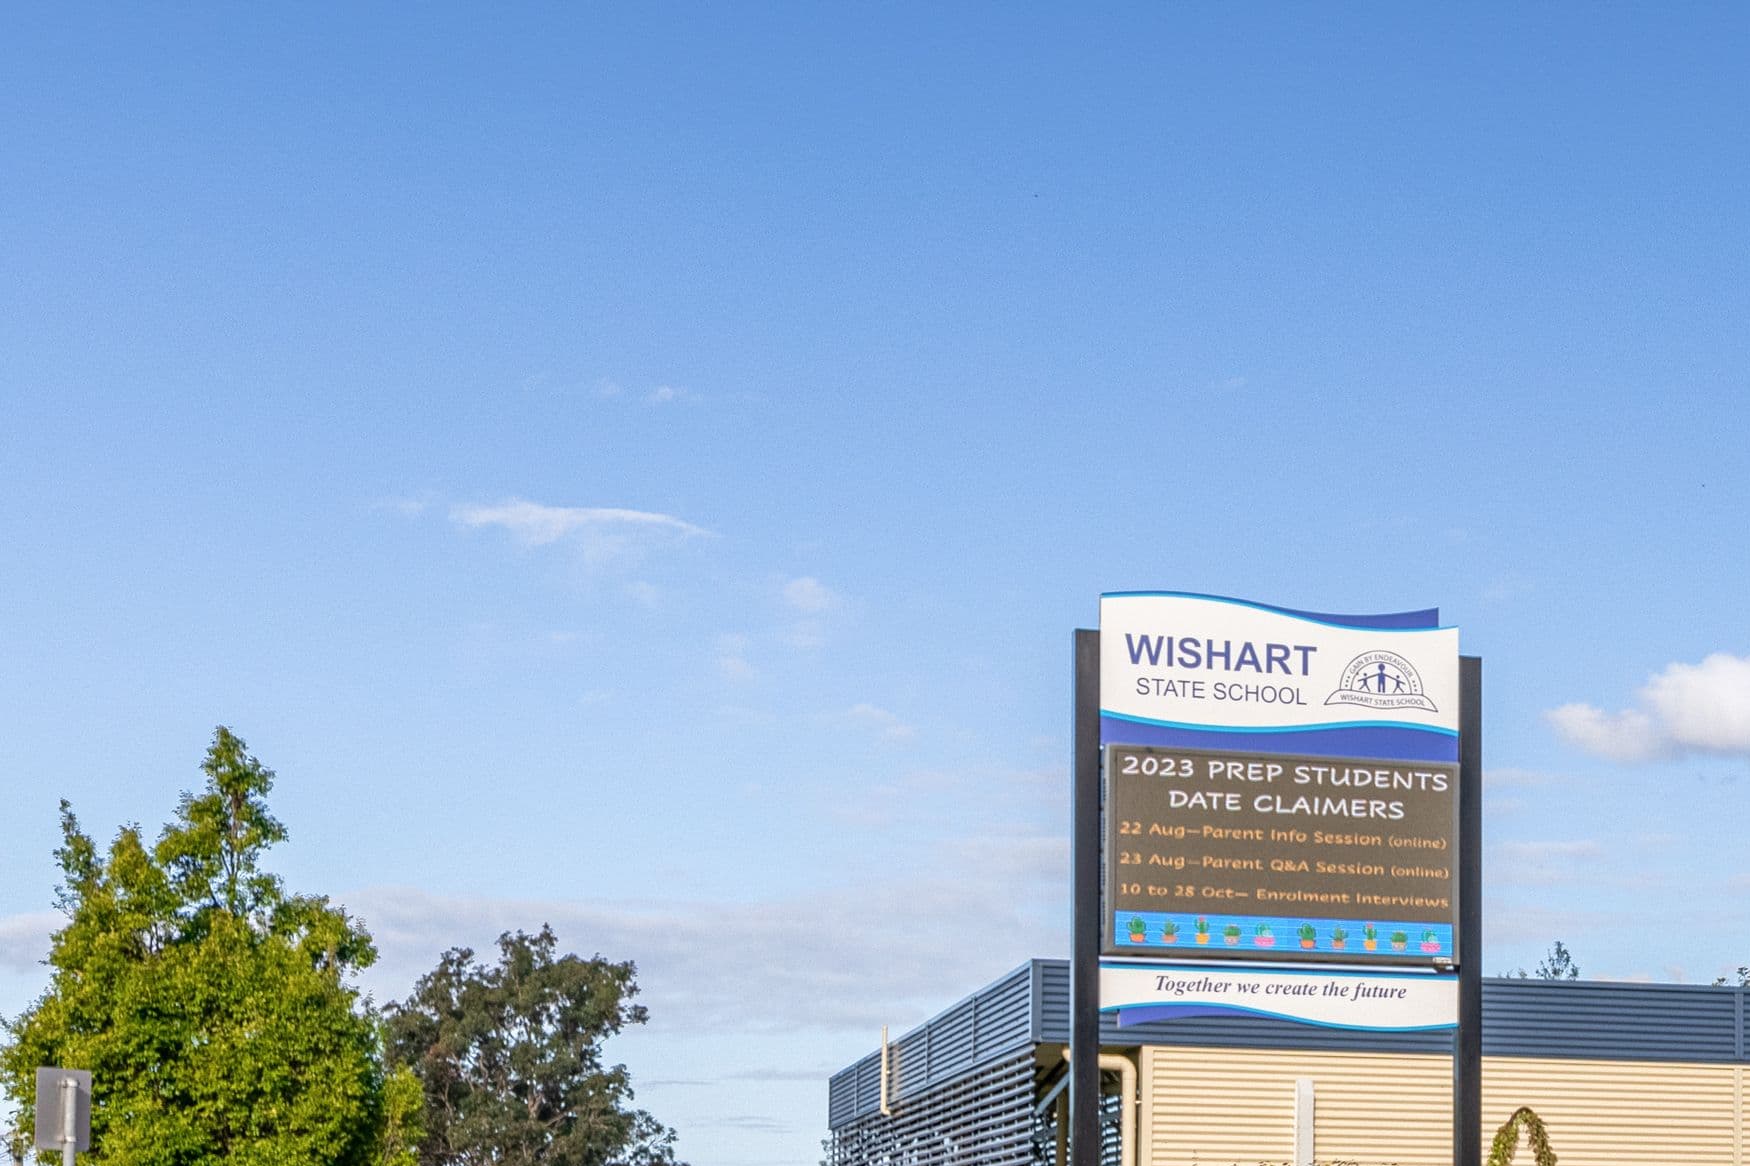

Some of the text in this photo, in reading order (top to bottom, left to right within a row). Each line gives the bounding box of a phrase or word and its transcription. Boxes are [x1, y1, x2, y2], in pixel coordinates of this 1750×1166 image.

[1125, 633, 1317, 676] WISHART
[1349, 654, 1414, 677] GAIN BY ENDEAVOUR
[1136, 677, 1307, 706] STATE SCHOOL
[1340, 694, 1425, 706] WISHART STATE SCHOOL
[1121, 756, 1449, 792] 2023 PREP STUDENTS
[1169, 790, 1405, 819] DATE CLAIMERS
[1119, 821, 1142, 835] 22
[1271, 829, 1307, 842] Info
[1314, 830, 1382, 846] Session
[1388, 835, 1448, 850] (online)
[1119, 852, 1142, 865] 23
[1270, 859, 1310, 873] Q&A
[1316, 860, 1384, 875] Session
[1390, 864, 1449, 880] (online)
[1120, 883, 1141, 895] 10
[1148, 884, 1168, 896] to
[1174, 884, 1195, 897] 28
[1256, 889, 1350, 904] Enrolment
[1356, 892, 1449, 909] Interviews
[1155, 975, 1407, 1001] Together we create the future
